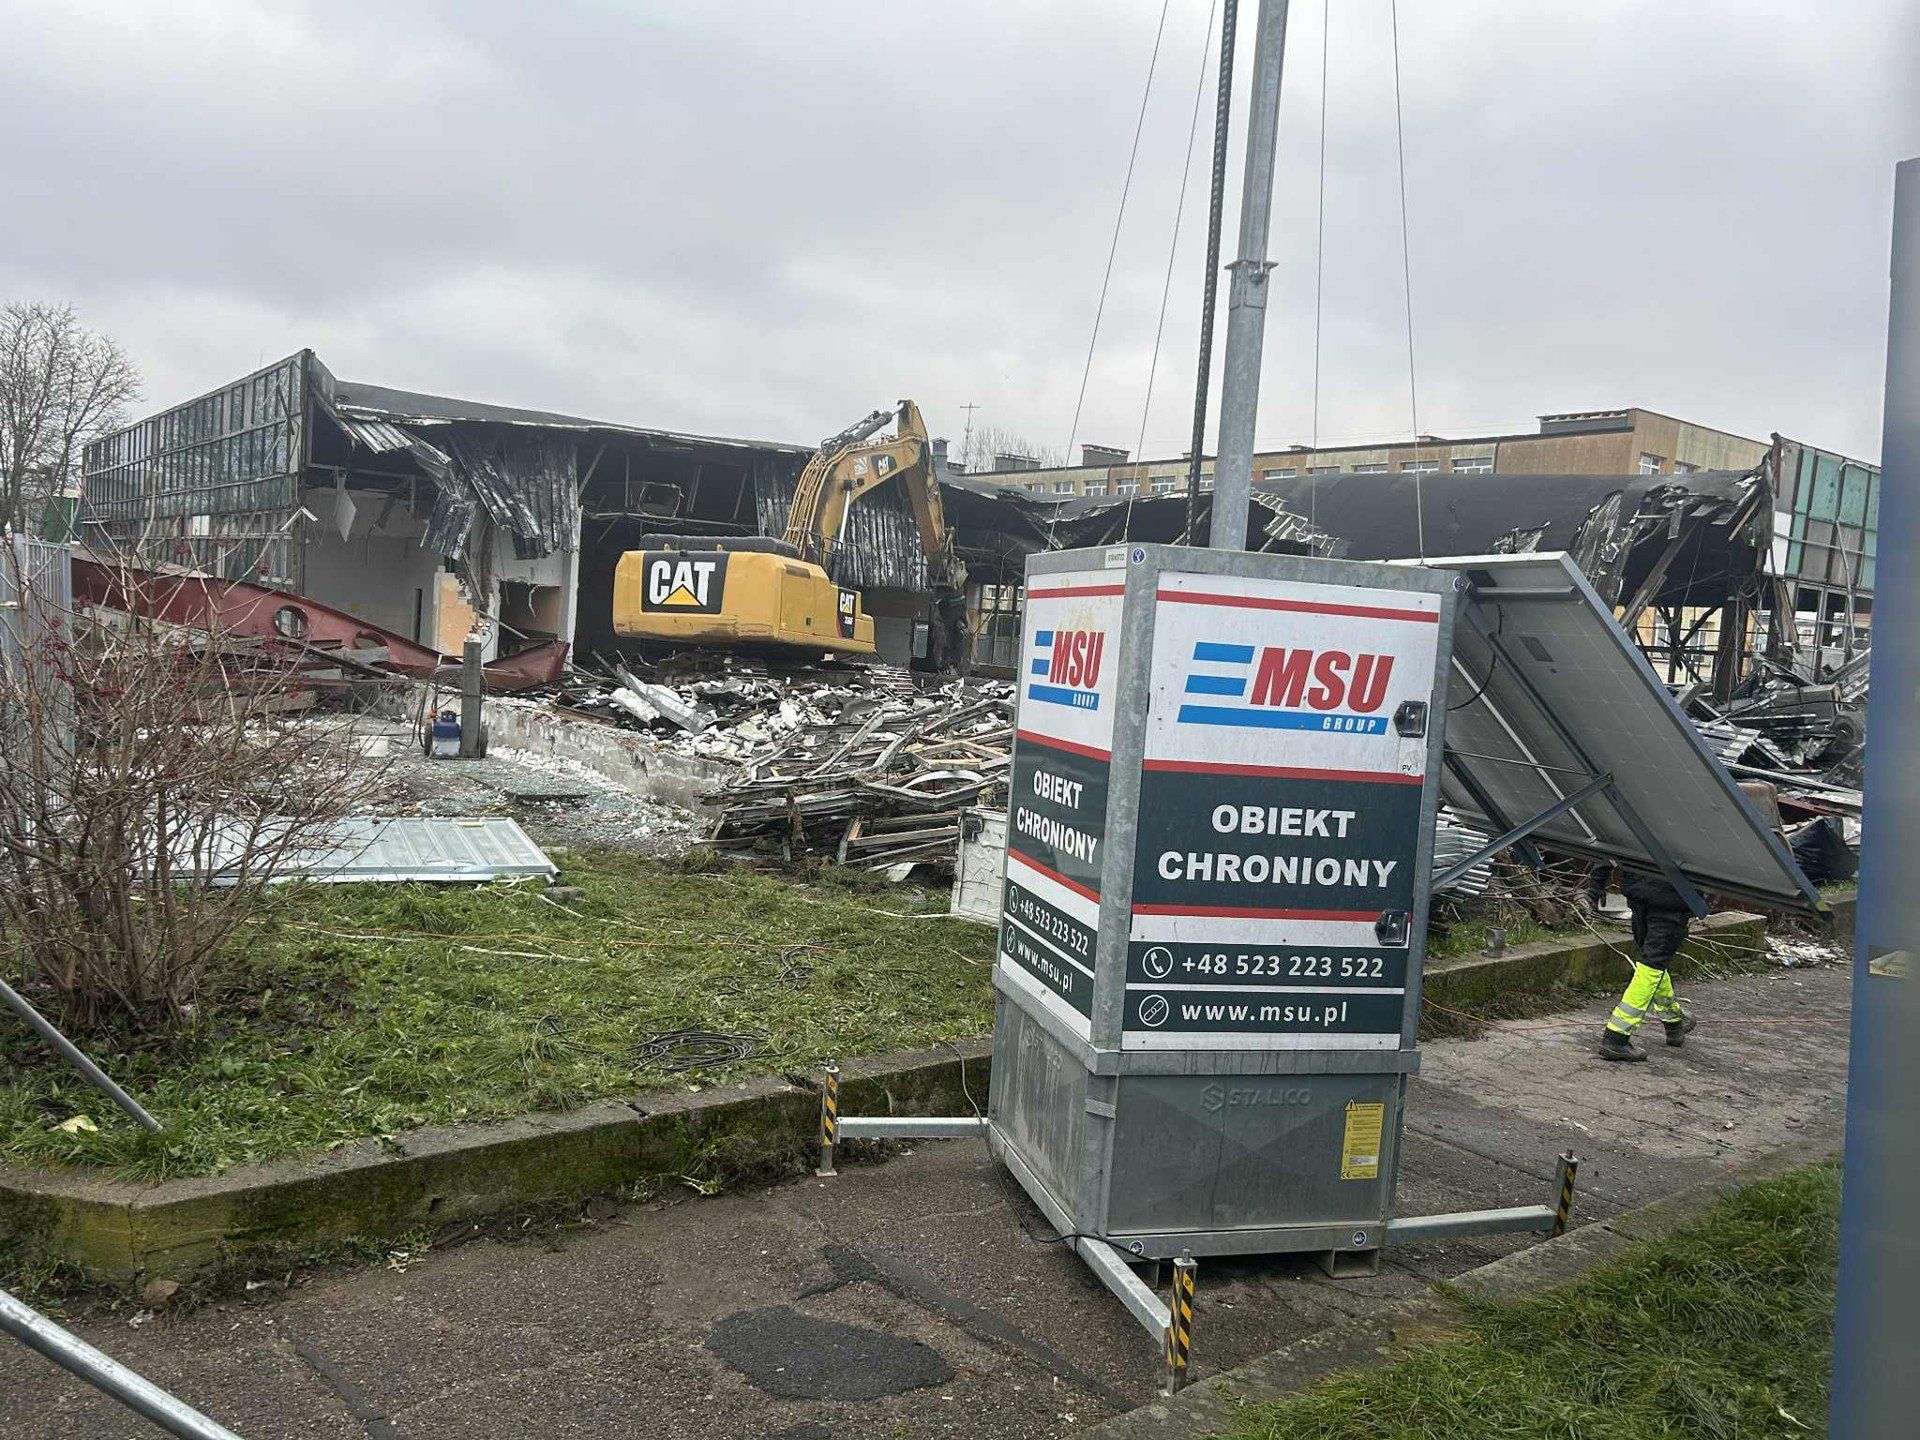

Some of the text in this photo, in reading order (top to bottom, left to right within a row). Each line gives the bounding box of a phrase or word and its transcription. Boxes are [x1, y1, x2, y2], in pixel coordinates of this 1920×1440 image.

[877, 455, 890, 477] CAT
[649, 560, 716, 607] CAT
[840, 592, 855, 615] CAT
[1049, 629, 1105, 689] MSU
[1249, 646, 1395, 713] MSU
[1072, 692, 1095, 708] GROUP
[1322, 716, 1376, 732] GROUP
[1033, 770, 1083, 810] OBIEKT
[1016, 806, 1097, 865] CHRONIONY
[1211, 804, 1356, 838] OBIEKT
[1158, 850, 1397, 888] CHRONIONY
[1020, 899, 1088, 956] +48 523 223 522
[1017, 940, 1073, 994] www.msu.pl
[1182, 953, 1383, 978] +48 523 223 522
[1181, 1001, 1347, 1027] www.msu.pl
[1229, 1088, 1312, 1108] STALICO
